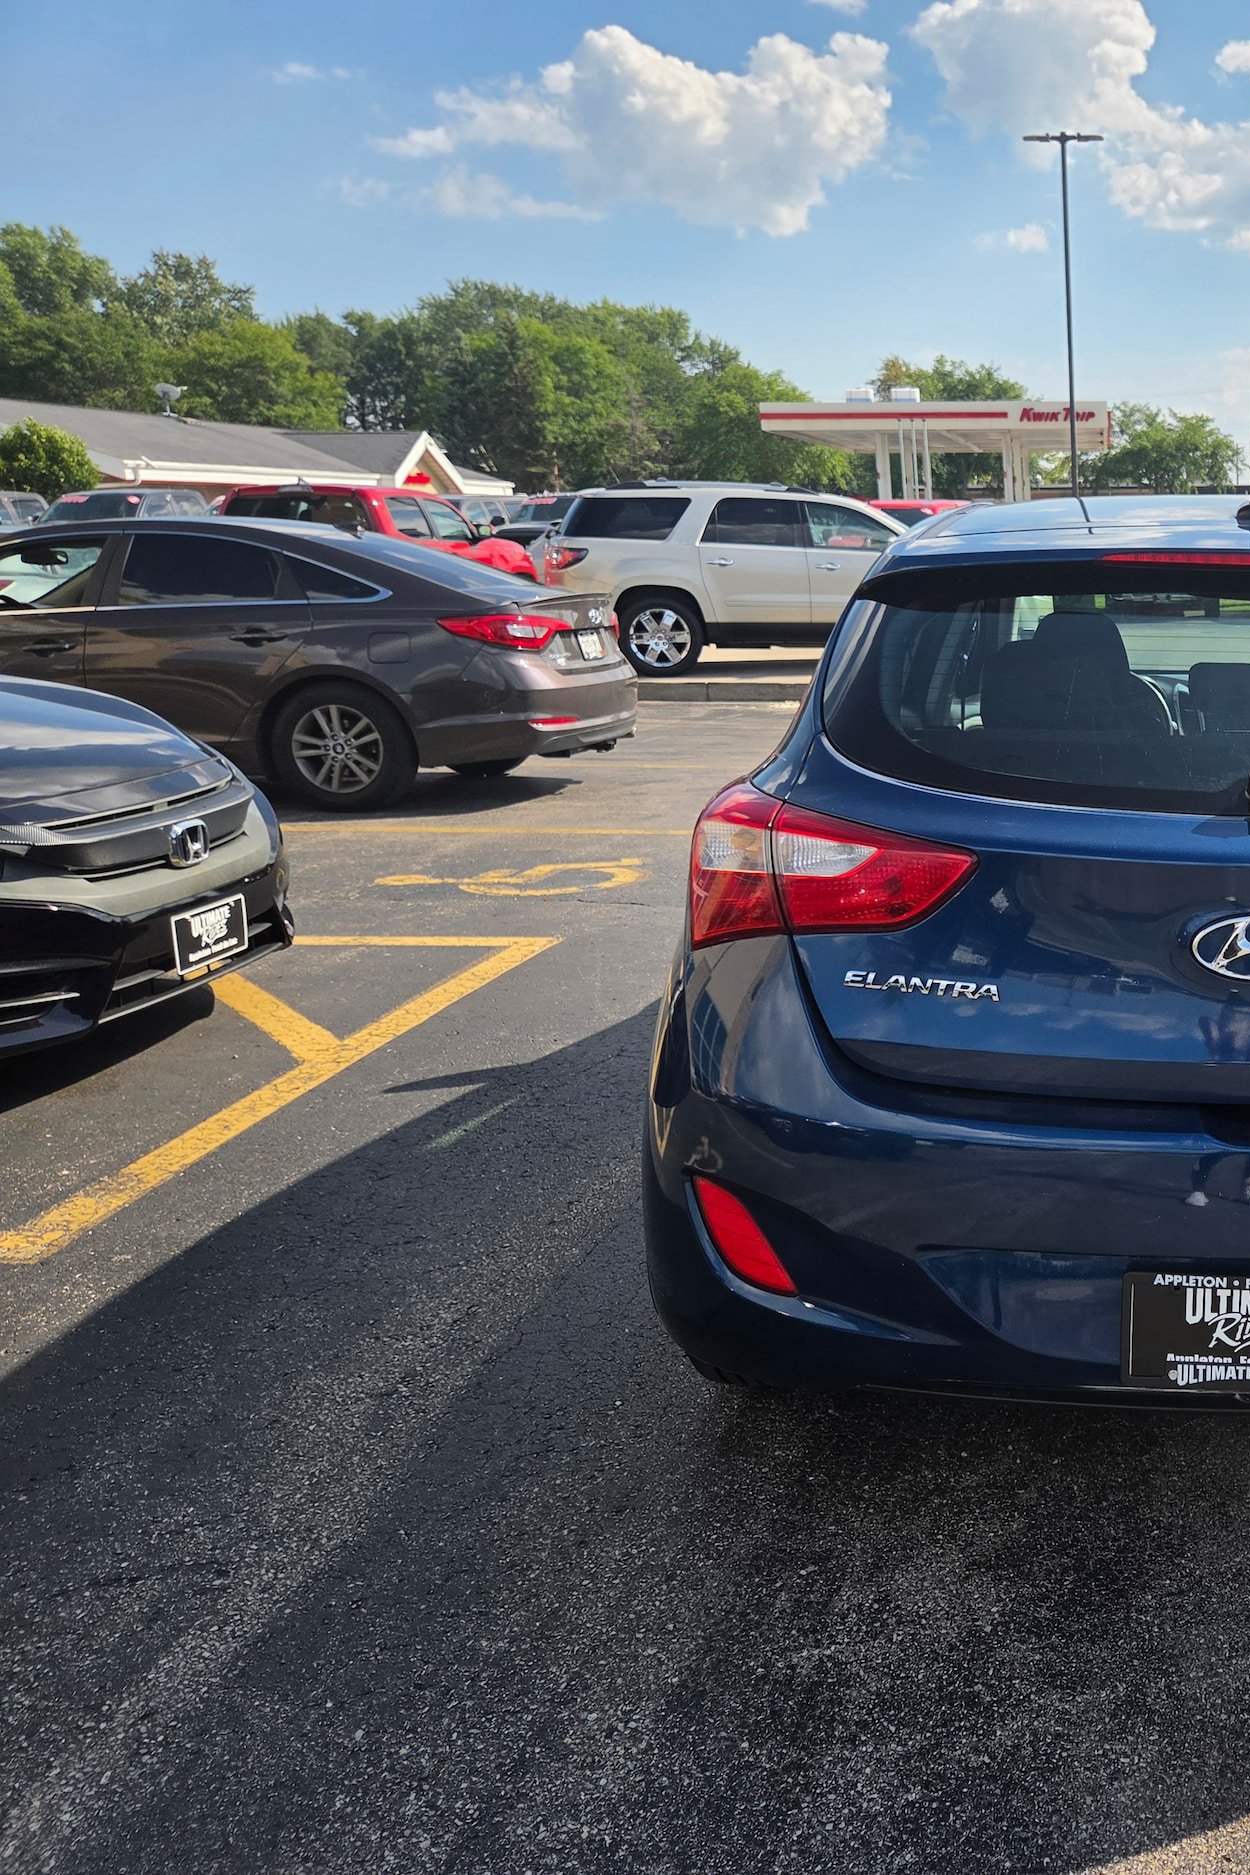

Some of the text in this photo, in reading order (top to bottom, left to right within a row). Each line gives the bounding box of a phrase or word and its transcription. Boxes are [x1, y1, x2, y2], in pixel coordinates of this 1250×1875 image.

[1019, 407, 1061, 422] KWIK
[843, 970, 1000, 1002] ELANTRA
[1153, 1274, 1227, 1288] APPLETON
